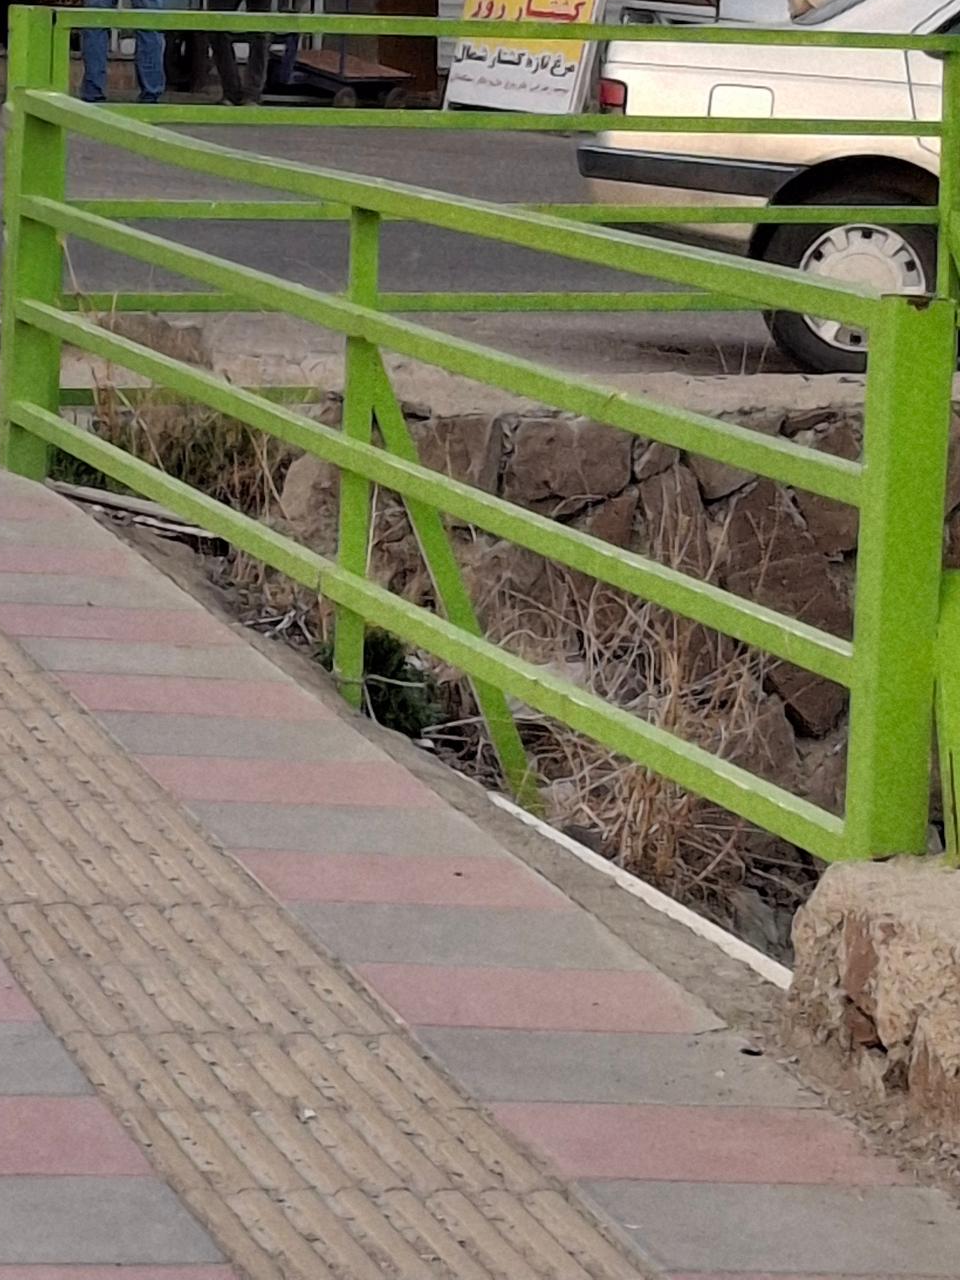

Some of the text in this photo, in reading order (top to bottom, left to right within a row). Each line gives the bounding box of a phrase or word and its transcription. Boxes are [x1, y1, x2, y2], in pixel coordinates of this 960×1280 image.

[454, 43, 488, 63] شمال
[488, 48, 525, 68] کشتار
[550, 55, 575, 77] مرغ
